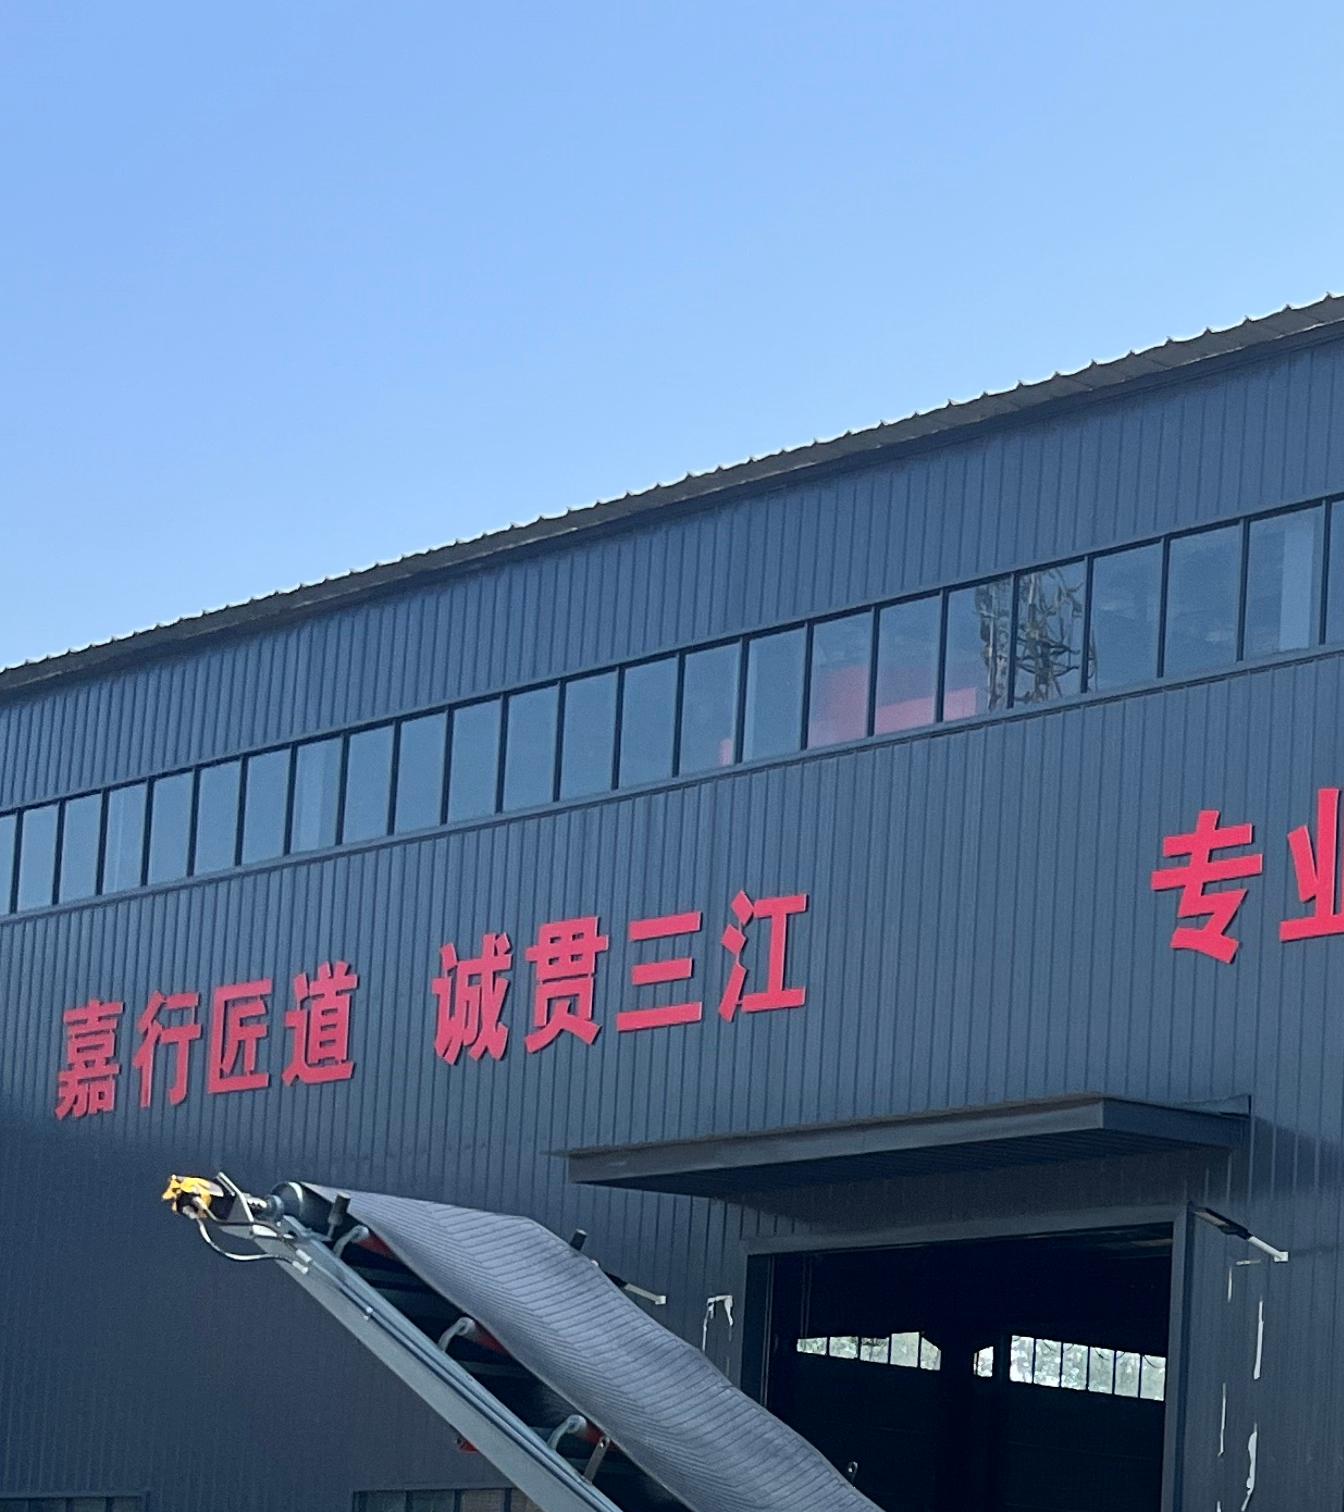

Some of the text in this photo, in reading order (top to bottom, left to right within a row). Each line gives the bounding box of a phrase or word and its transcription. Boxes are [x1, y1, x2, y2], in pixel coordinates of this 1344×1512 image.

[55, 890, 808, 1120] 嘉行匠道 诚贯三江
